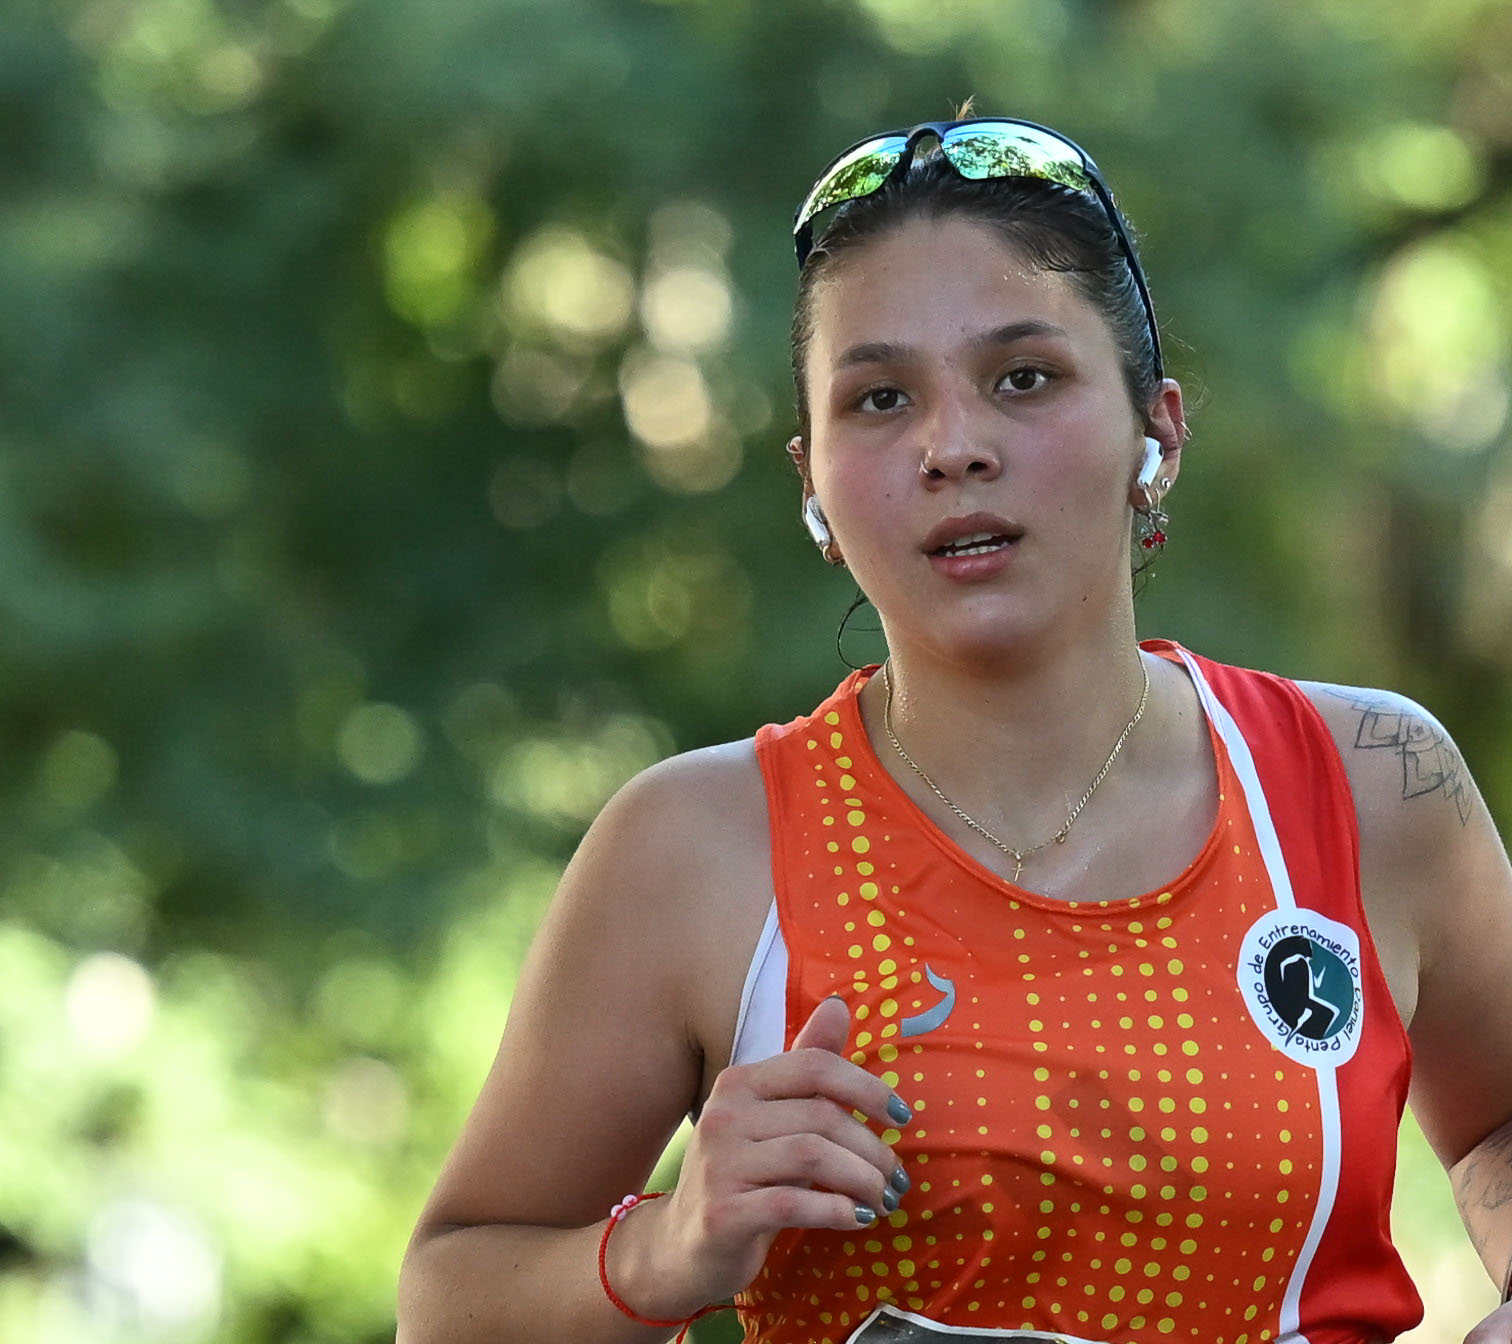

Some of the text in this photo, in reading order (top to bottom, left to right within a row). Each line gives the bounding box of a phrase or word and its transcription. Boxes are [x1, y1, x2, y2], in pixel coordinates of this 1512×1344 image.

[1247, 954, 1264, 974] de
[1258, 924, 1359, 978] Entrenamiento
[1254, 982, 1289, 1037] Grupo
[1295, 1035, 1341, 1053] Penta
